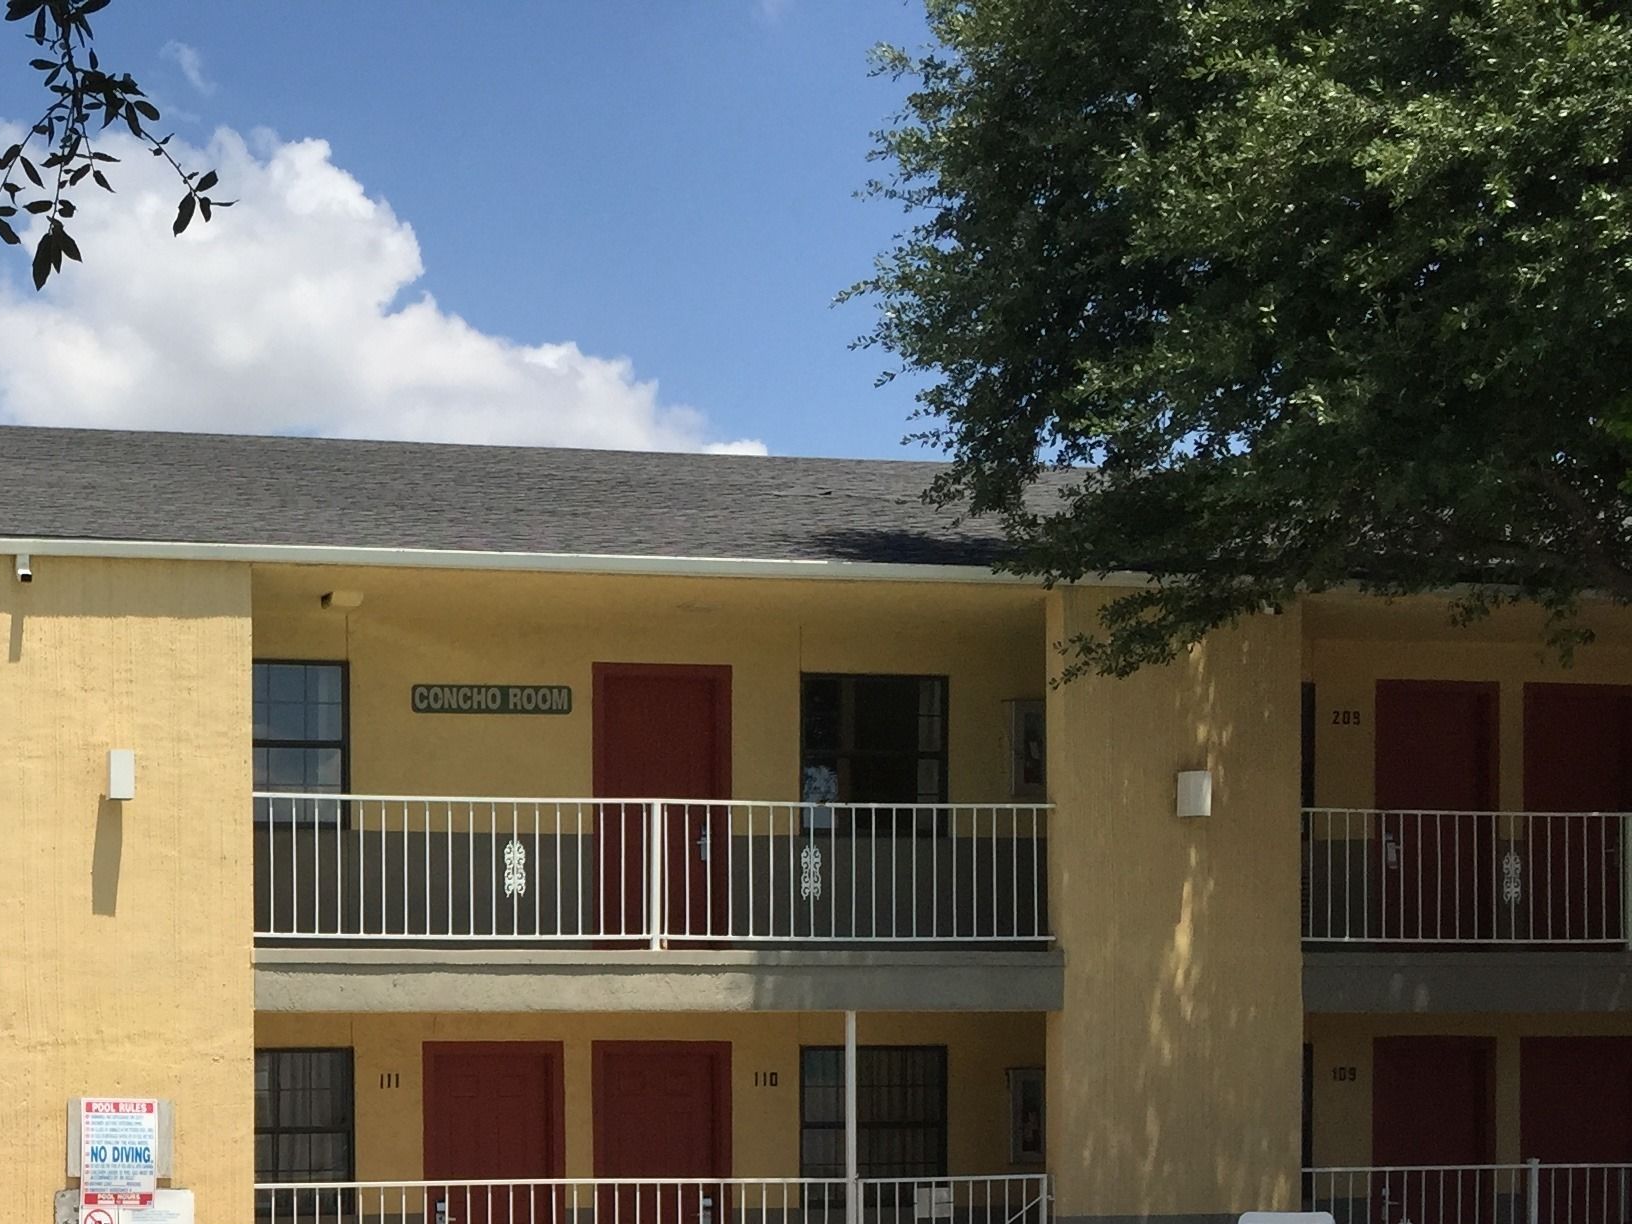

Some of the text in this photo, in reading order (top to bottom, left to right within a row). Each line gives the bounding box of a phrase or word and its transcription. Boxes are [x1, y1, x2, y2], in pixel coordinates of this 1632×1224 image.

[414, 686, 568, 711] CONCHO ROOM
[1332, 710, 1361, 726] 209
[380, 1072, 400, 1090] 111
[754, 1071, 778, 1088] 110
[1331, 1066, 1357, 1081] 109
[91, 1102, 148, 1114] POOL RULES
[90, 1145, 108, 1163] NO
